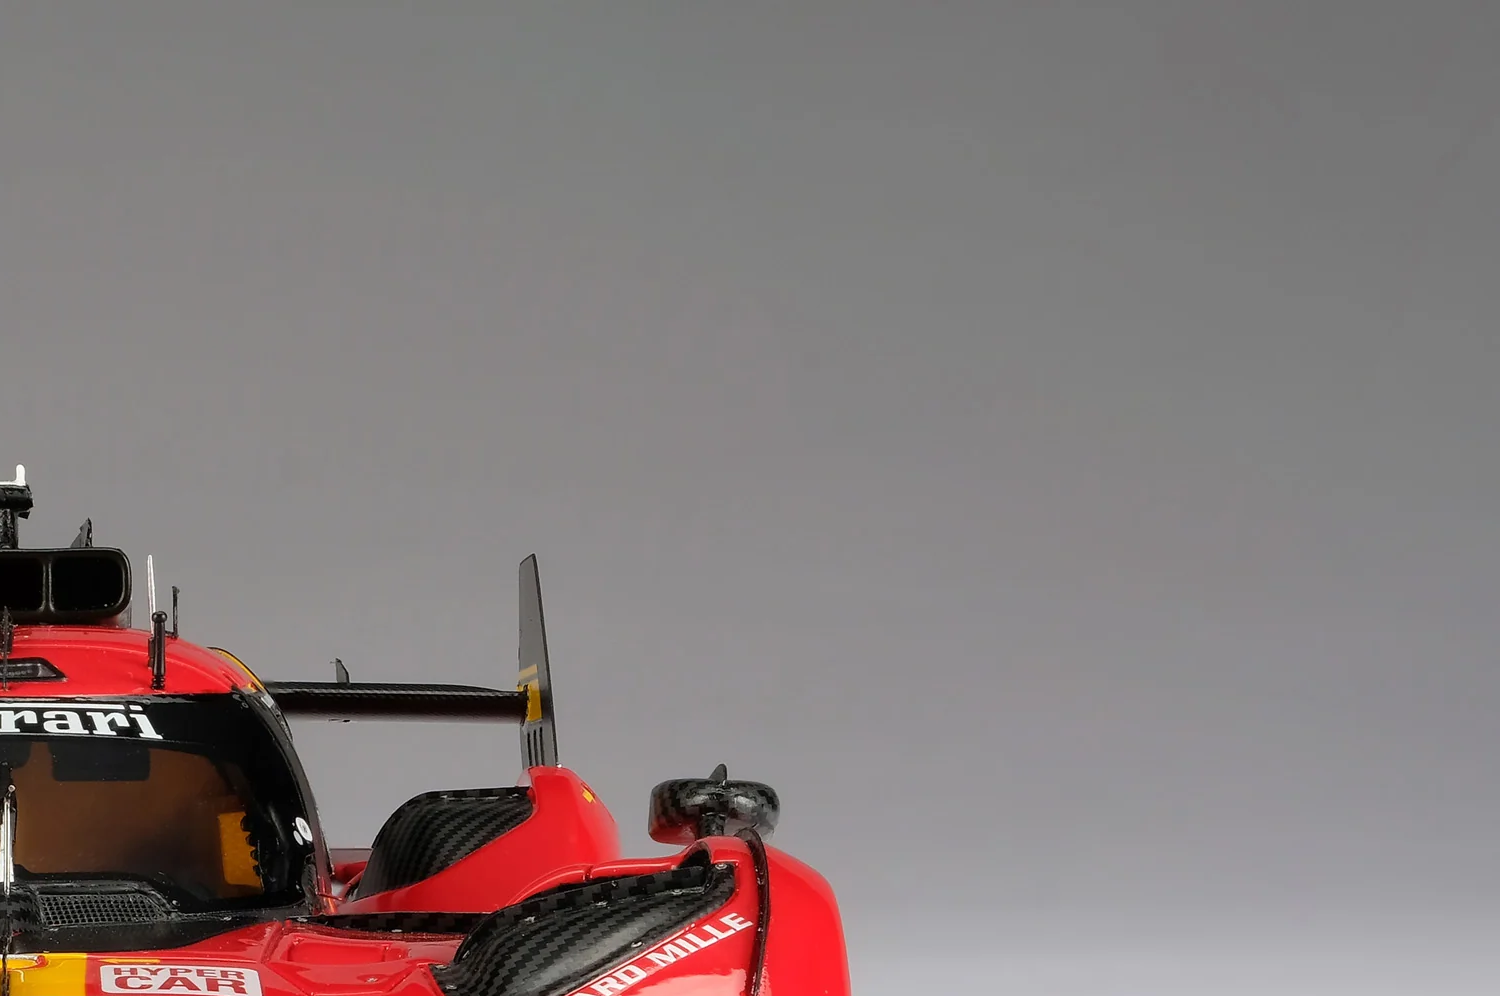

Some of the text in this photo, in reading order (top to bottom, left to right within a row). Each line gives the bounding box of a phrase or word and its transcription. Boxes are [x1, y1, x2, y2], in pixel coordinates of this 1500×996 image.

[651, 911, 754, 969] MILLE
[113, 967, 246, 980] HYPER
[114, 975, 248, 995] CAR
